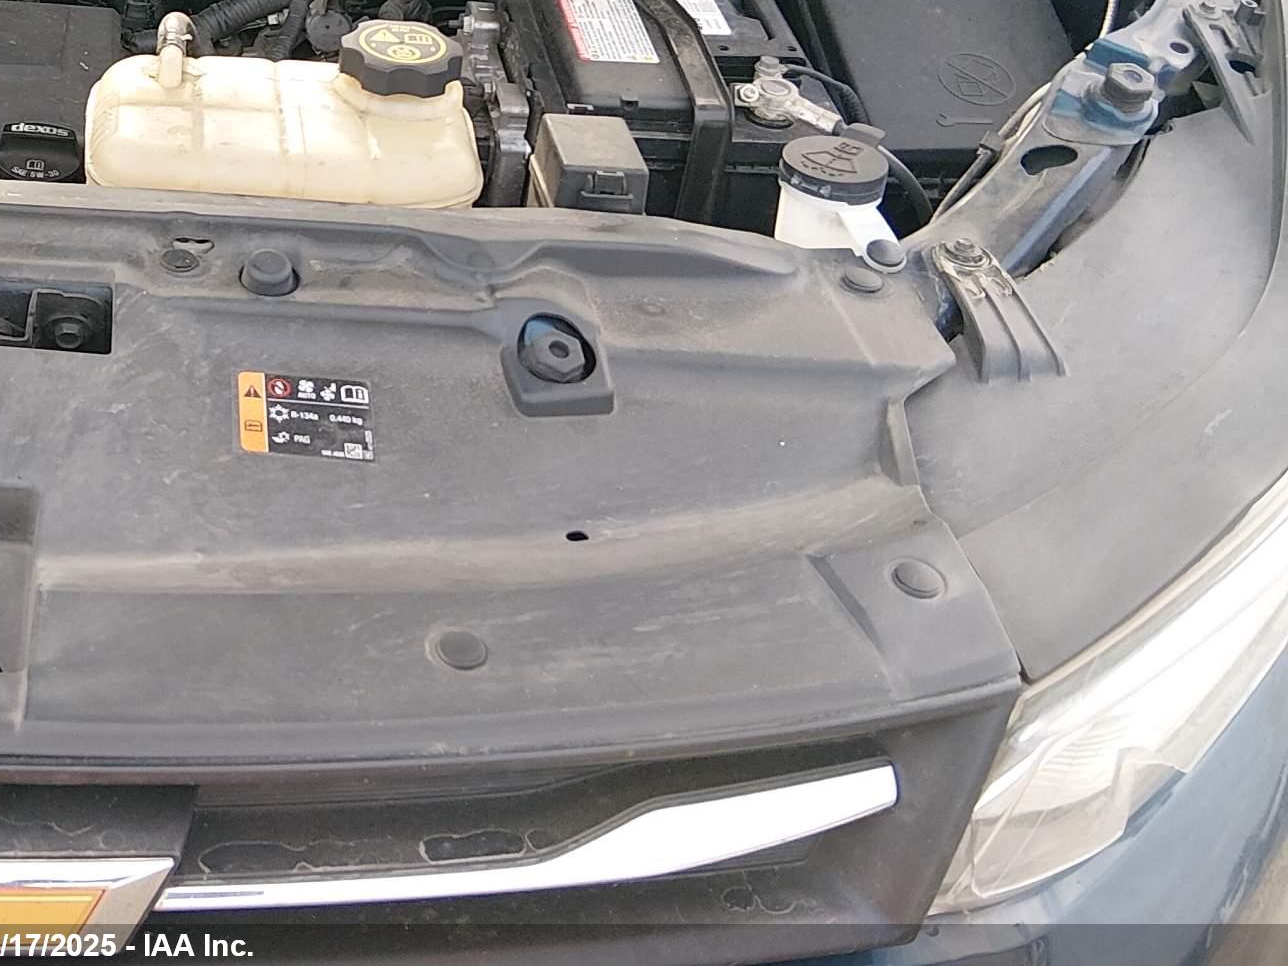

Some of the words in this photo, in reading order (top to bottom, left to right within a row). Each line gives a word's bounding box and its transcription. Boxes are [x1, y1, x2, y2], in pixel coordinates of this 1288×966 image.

[11, 123, 69, 137] dexos
[11, 166, 28, 177] SAE
[30, 169, 60, 178] 5W-30
[297, 392, 316, 400] AUTO
[290, 410, 319, 421] R-134a
[294, 435, 310, 445] PAG
